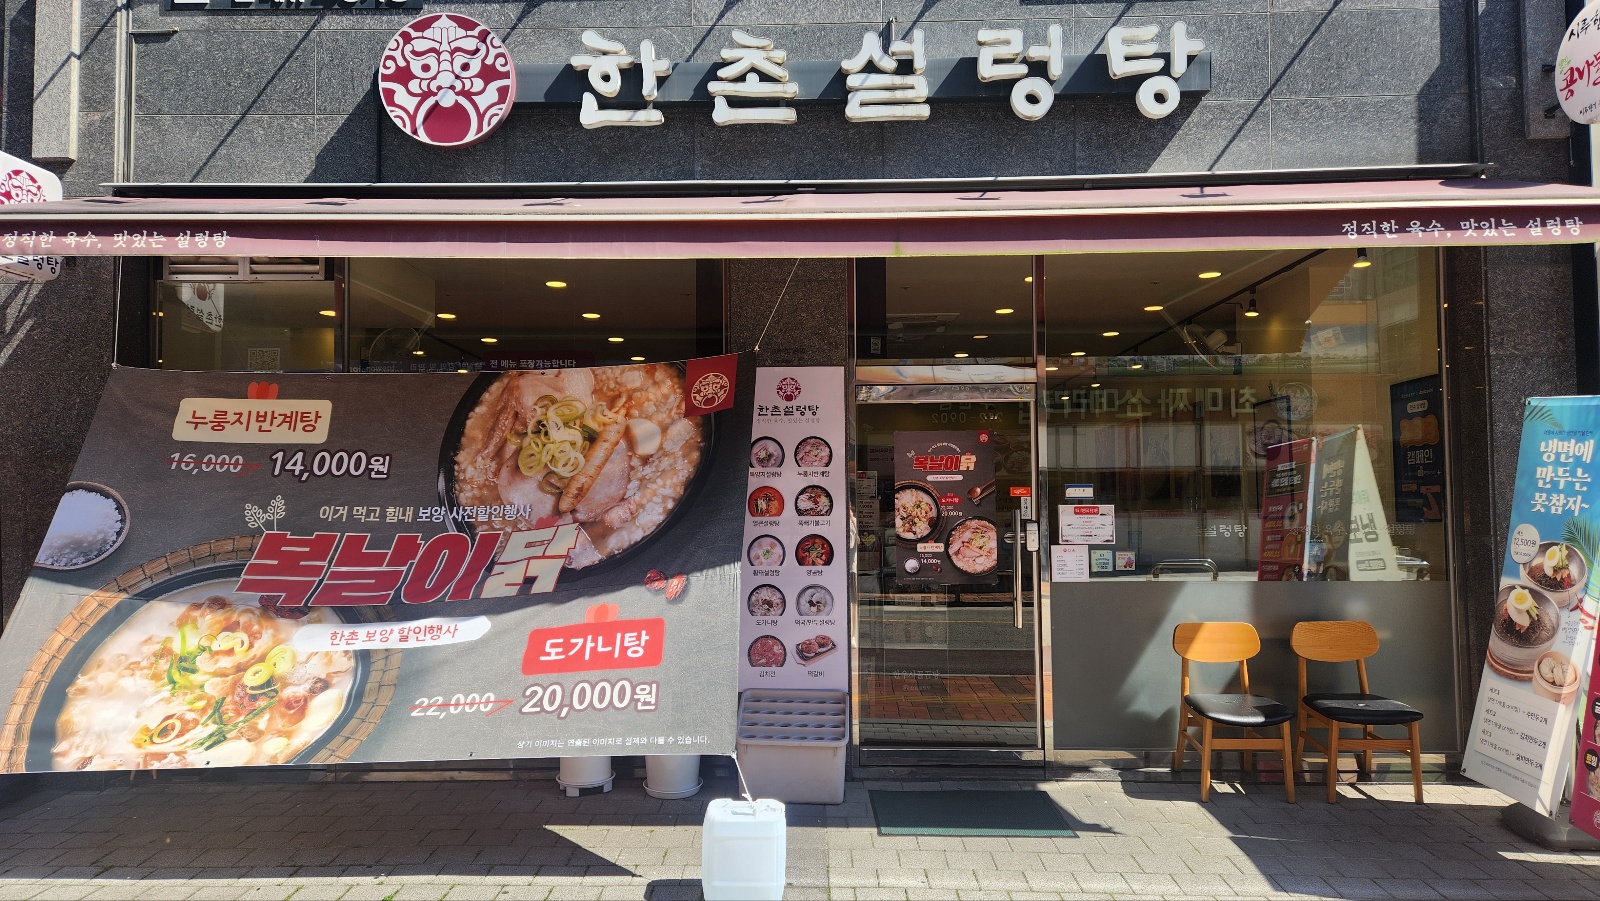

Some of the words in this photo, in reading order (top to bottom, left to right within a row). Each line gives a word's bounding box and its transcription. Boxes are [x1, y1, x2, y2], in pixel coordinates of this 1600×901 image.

[570, 21, 1205, 127] 한촌설렁탕
[1341, 219, 1399, 239] 정직한
[1406, 219, 1451, 239] 육수,
[1460, 217, 1517, 237] 맛있는
[1526, 216, 1583, 236] 설렁탕
[1, 231, 56, 248] 정직한
[62, 231, 102, 249] 육수,
[113, 230, 167, 248] 맛있는
[174, 230, 230, 248] 설렁탕
[489, 359, 499, 368] 전
[500, 359, 517, 368] 메뉴
[519, 358, 577, 369] 포장가능합니다
[186, 409, 323, 433] 누룽지반계탕
[757, 405, 820, 416] 한촌설렁탕
[1407, 448, 1433, 465] 캠페인
[1540, 438, 1595, 464] 냉면에
[169, 452, 243, 475] 16,000
[269, 451, 391, 481] 14,000원
[912, 455, 977, 471] 복날이닭
[1536, 465, 1592, 492] 만두는
[319, 505, 348, 522] 이거
[352, 506, 381, 523] 먹고
[385, 506, 414, 523] 힘내
[416, 505, 447, 523] 보양
[450, 503, 532, 522] 사전할인행사
[1530, 492, 1590, 517] 못참지~
[234, 522, 581, 607] 복날이닭
[329, 630, 359, 646] 한촌
[362, 627, 394, 643] 보양
[397, 624, 459, 643] 할인행사
[539, 629, 650, 662] 도가니탕
[410, 692, 496, 719] 22,000
[520, 680, 659, 718] 20,000원
[517, 740, 532, 749] 상기
[534, 739, 565, 748] 이미지는
[592, 737, 623, 746] 이미지로
[625, 736, 648, 746] 실제와
[649, 736, 665, 745] 다를
[667, 736, 674, 745] 수
[677, 735, 710, 745] 있습니다.
